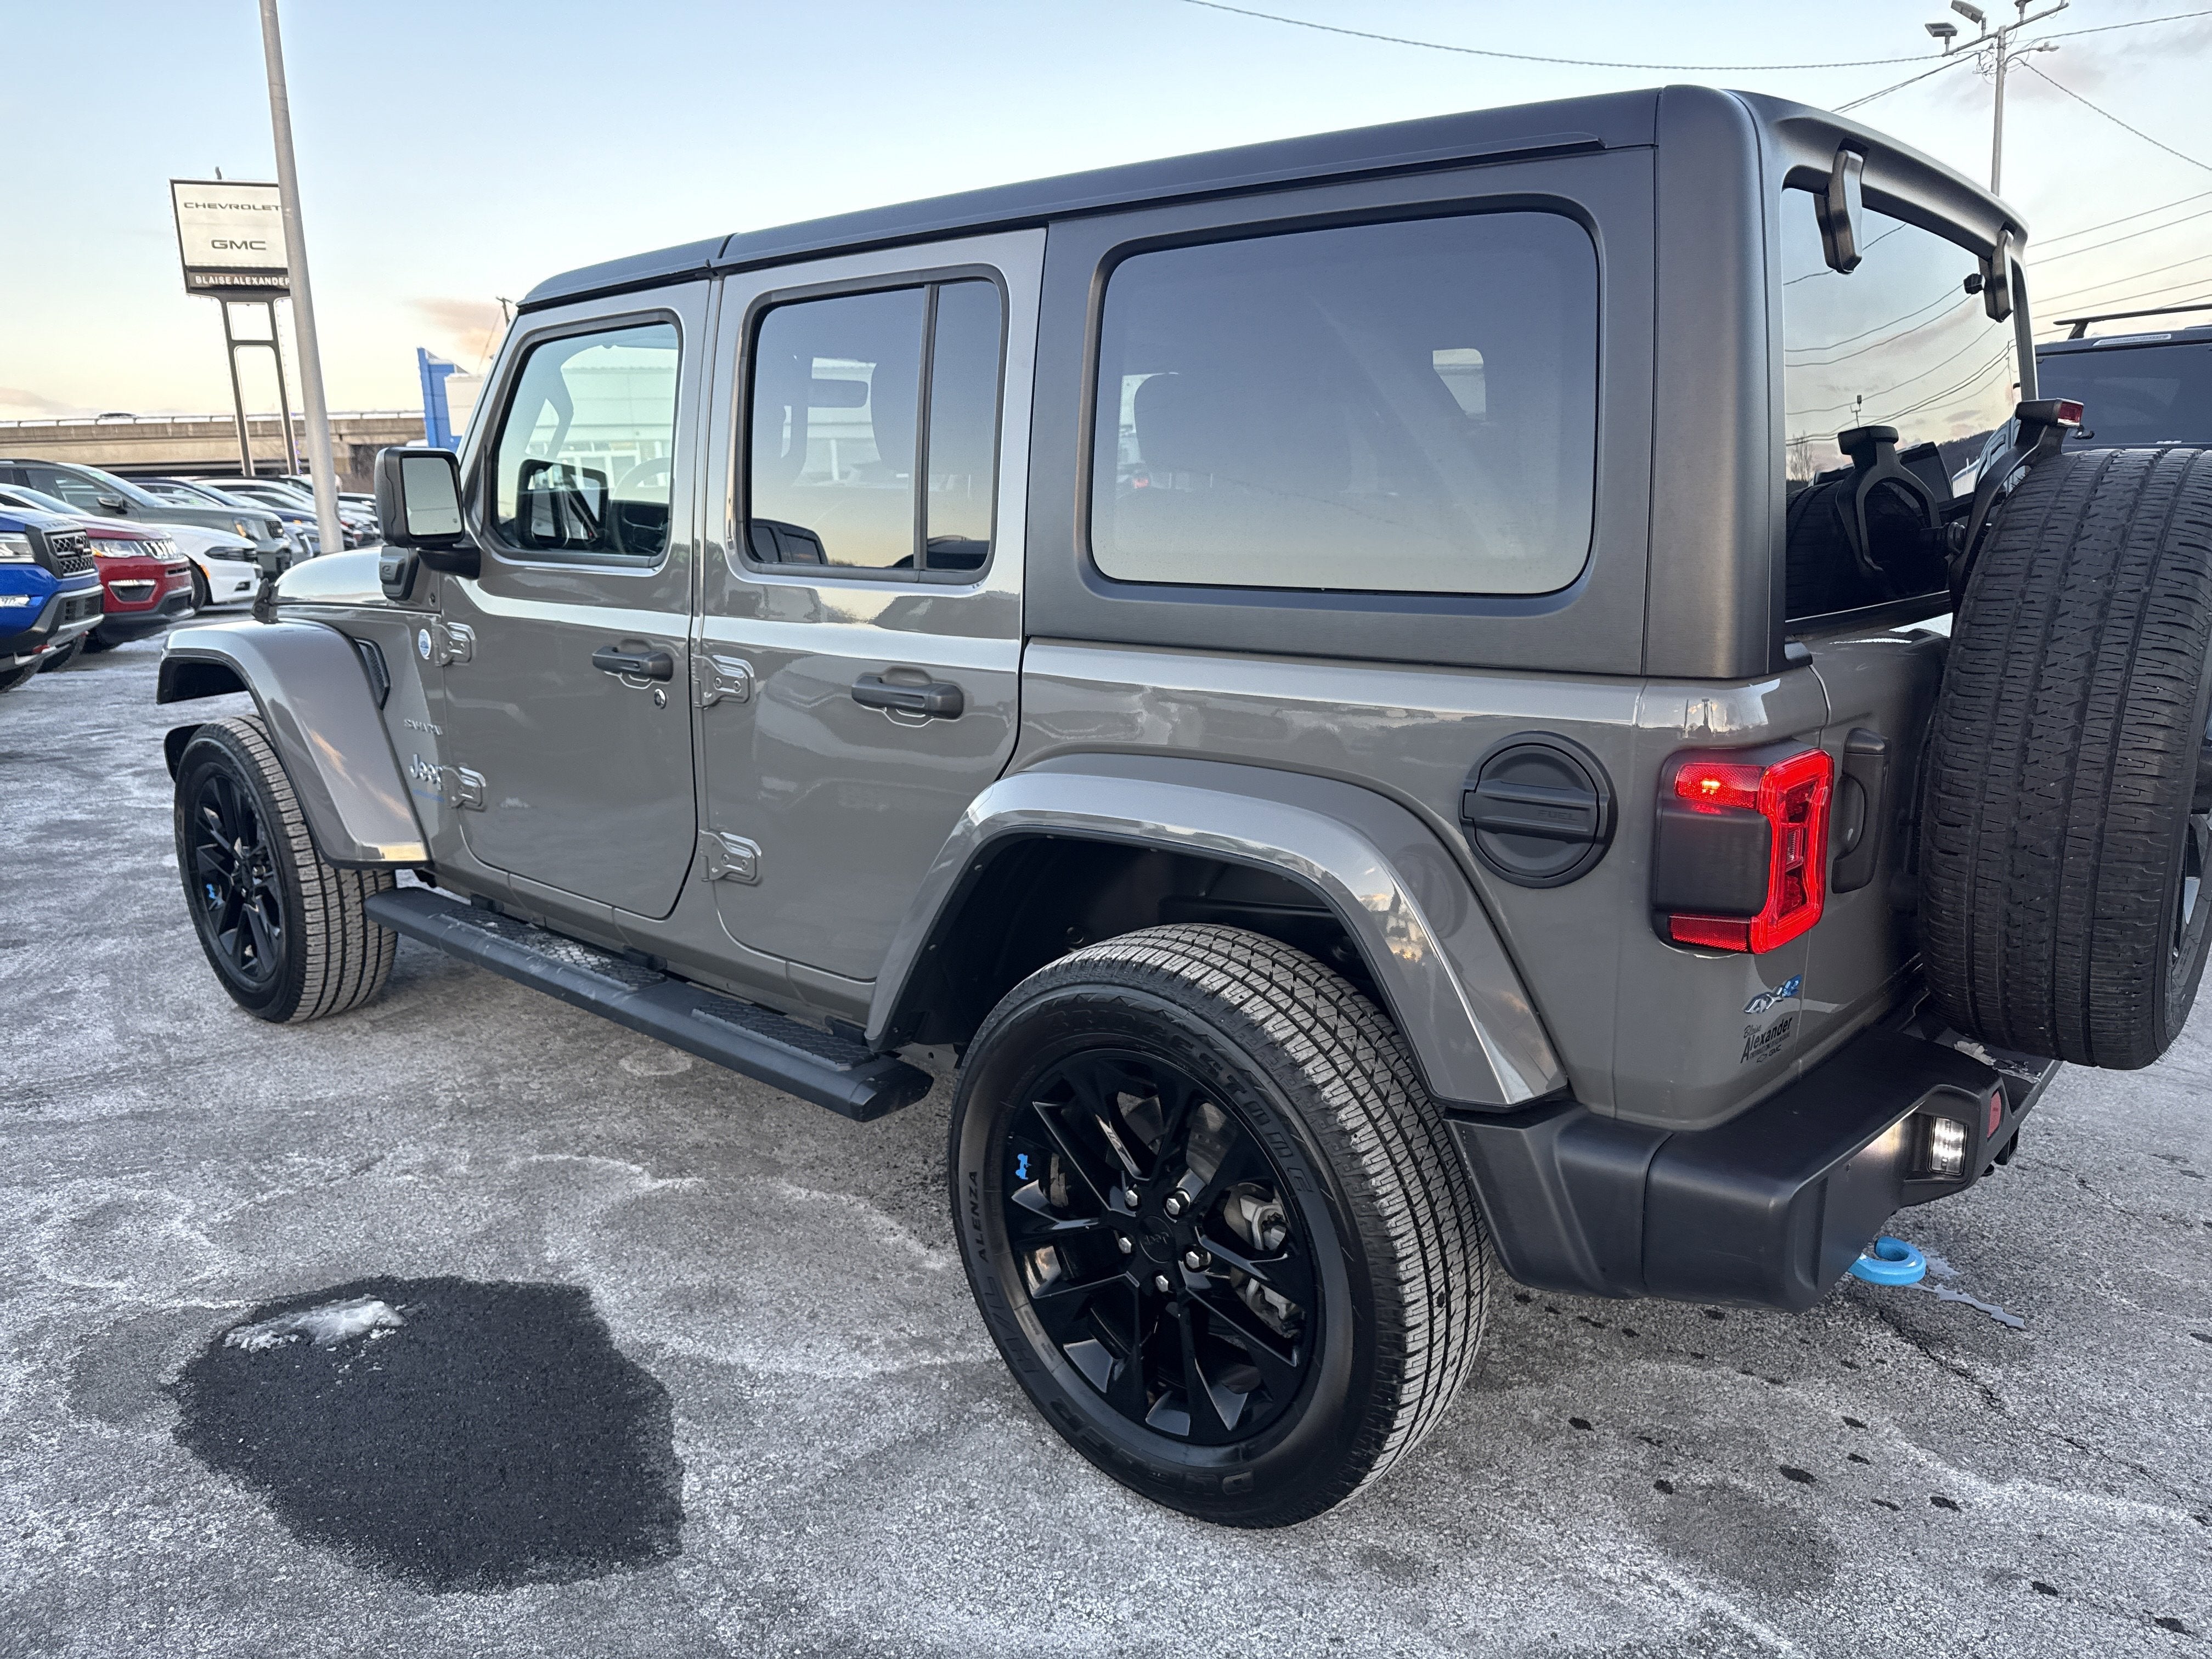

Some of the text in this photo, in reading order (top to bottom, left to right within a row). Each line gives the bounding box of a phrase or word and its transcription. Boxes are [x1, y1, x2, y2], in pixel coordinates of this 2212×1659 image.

[183, 202, 281, 211] CHEVROLET
[211, 239, 267, 250] GMC
[195, 275, 232, 285] BLAISE
[1536, 809, 1579, 821] FUEL
[1740, 1017, 1793, 1064] Alexander
[968, 1171, 990, 1263] ALENZA
